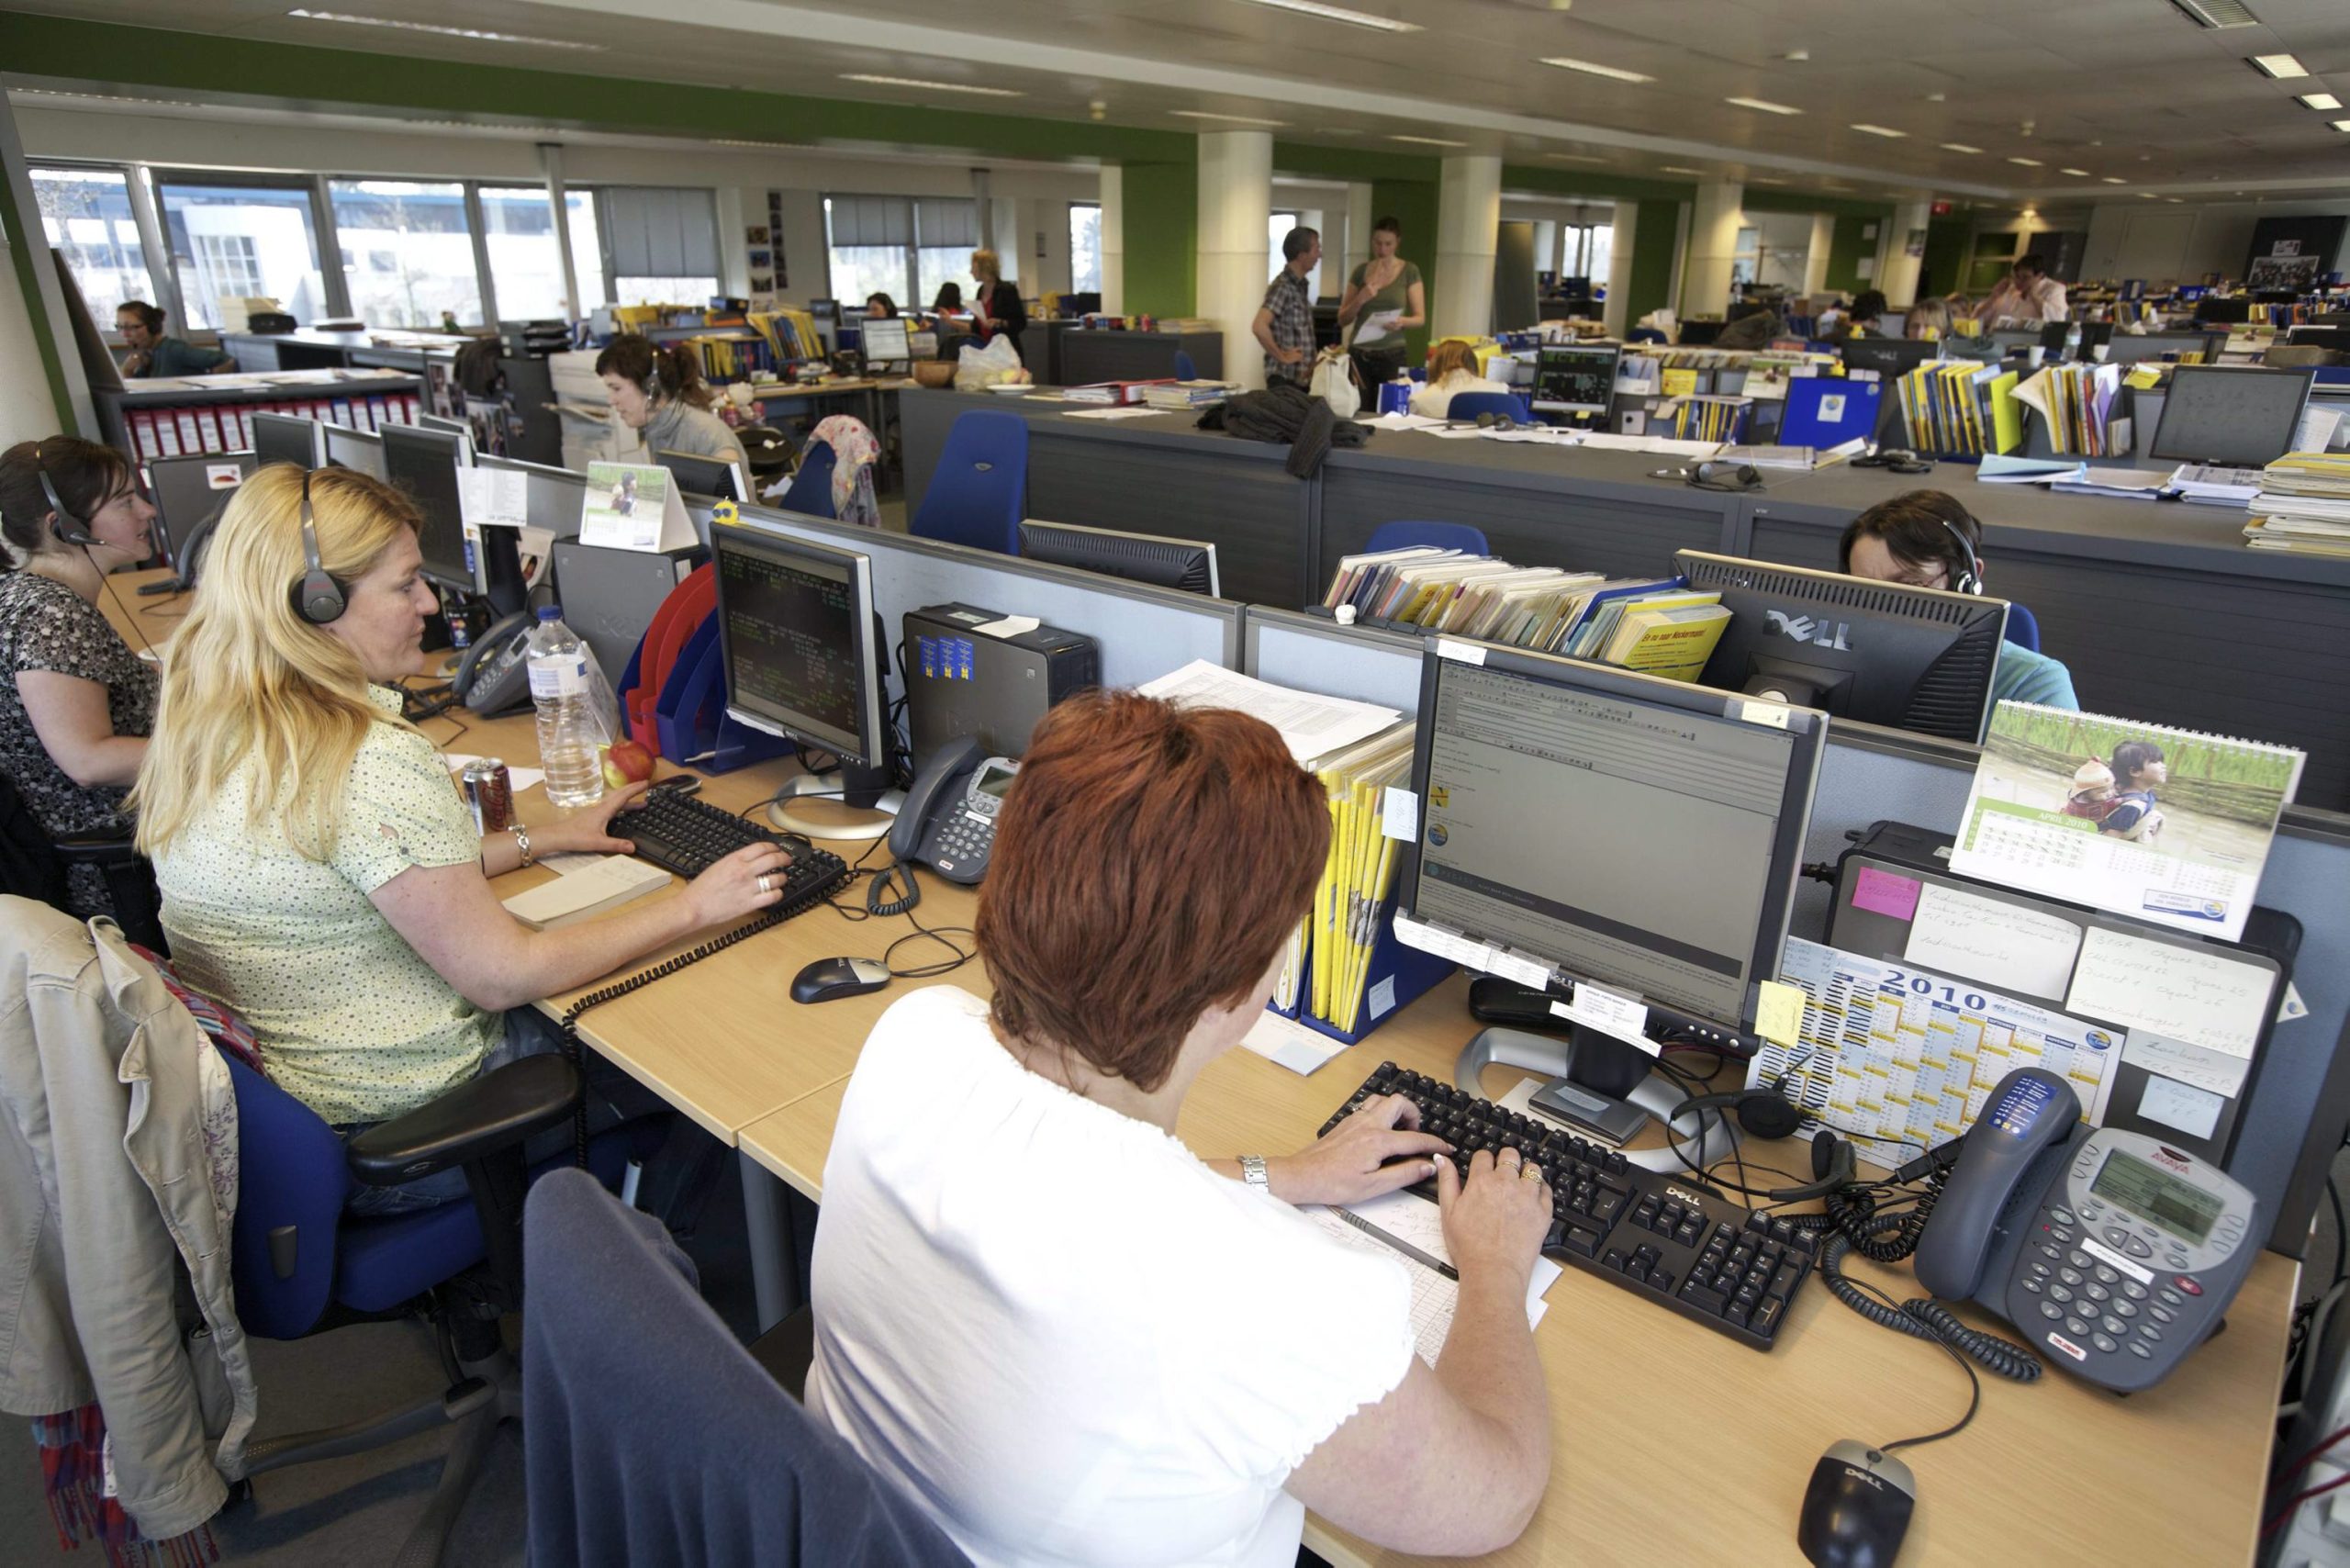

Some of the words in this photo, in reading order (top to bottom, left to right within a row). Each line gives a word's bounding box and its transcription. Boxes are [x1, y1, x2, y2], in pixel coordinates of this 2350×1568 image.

[1762, 610, 1853, 652] DELL
[2038, 812, 2063, 824] APRIL
[2065, 817, 2088, 830] 2010
[1883, 969, 1986, 1010] 2010
[2151, 1152, 2189, 1175] AVAYA
[1665, 1186, 1700, 1206] DELL
[1844, 1467, 1884, 1492] DELL
